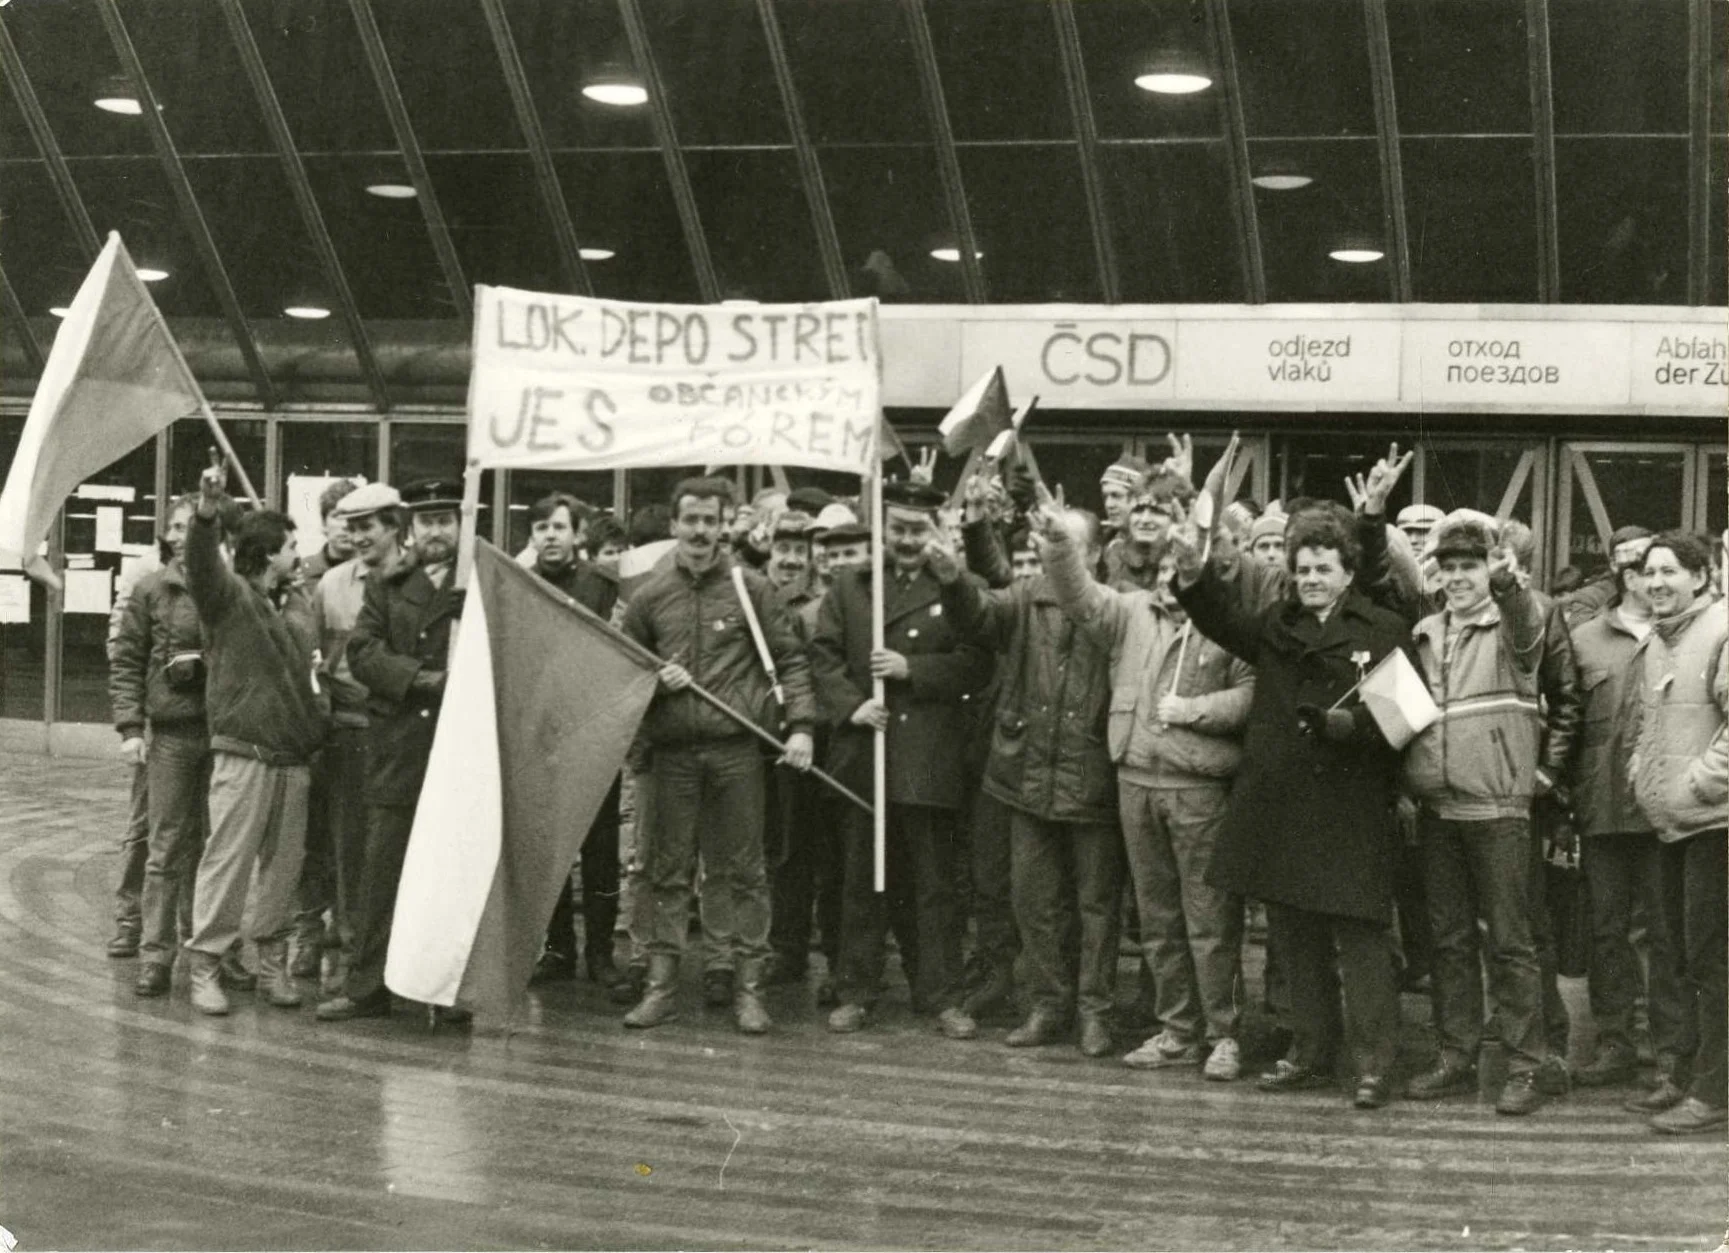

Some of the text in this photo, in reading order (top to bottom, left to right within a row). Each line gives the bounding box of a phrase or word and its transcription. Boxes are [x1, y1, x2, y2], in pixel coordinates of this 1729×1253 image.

[601, 308, 711, 365] DEPO
[1268, 334, 1351, 361] odjezd
[1041, 323, 1172, 386] ČSD
[1447, 340, 1521, 360] отход
[1267, 359, 1332, 382] vlaků
[1447, 365, 1560, 385] поездов
[1655, 361, 1700, 385] der
[489, 386, 617, 453] JE S
